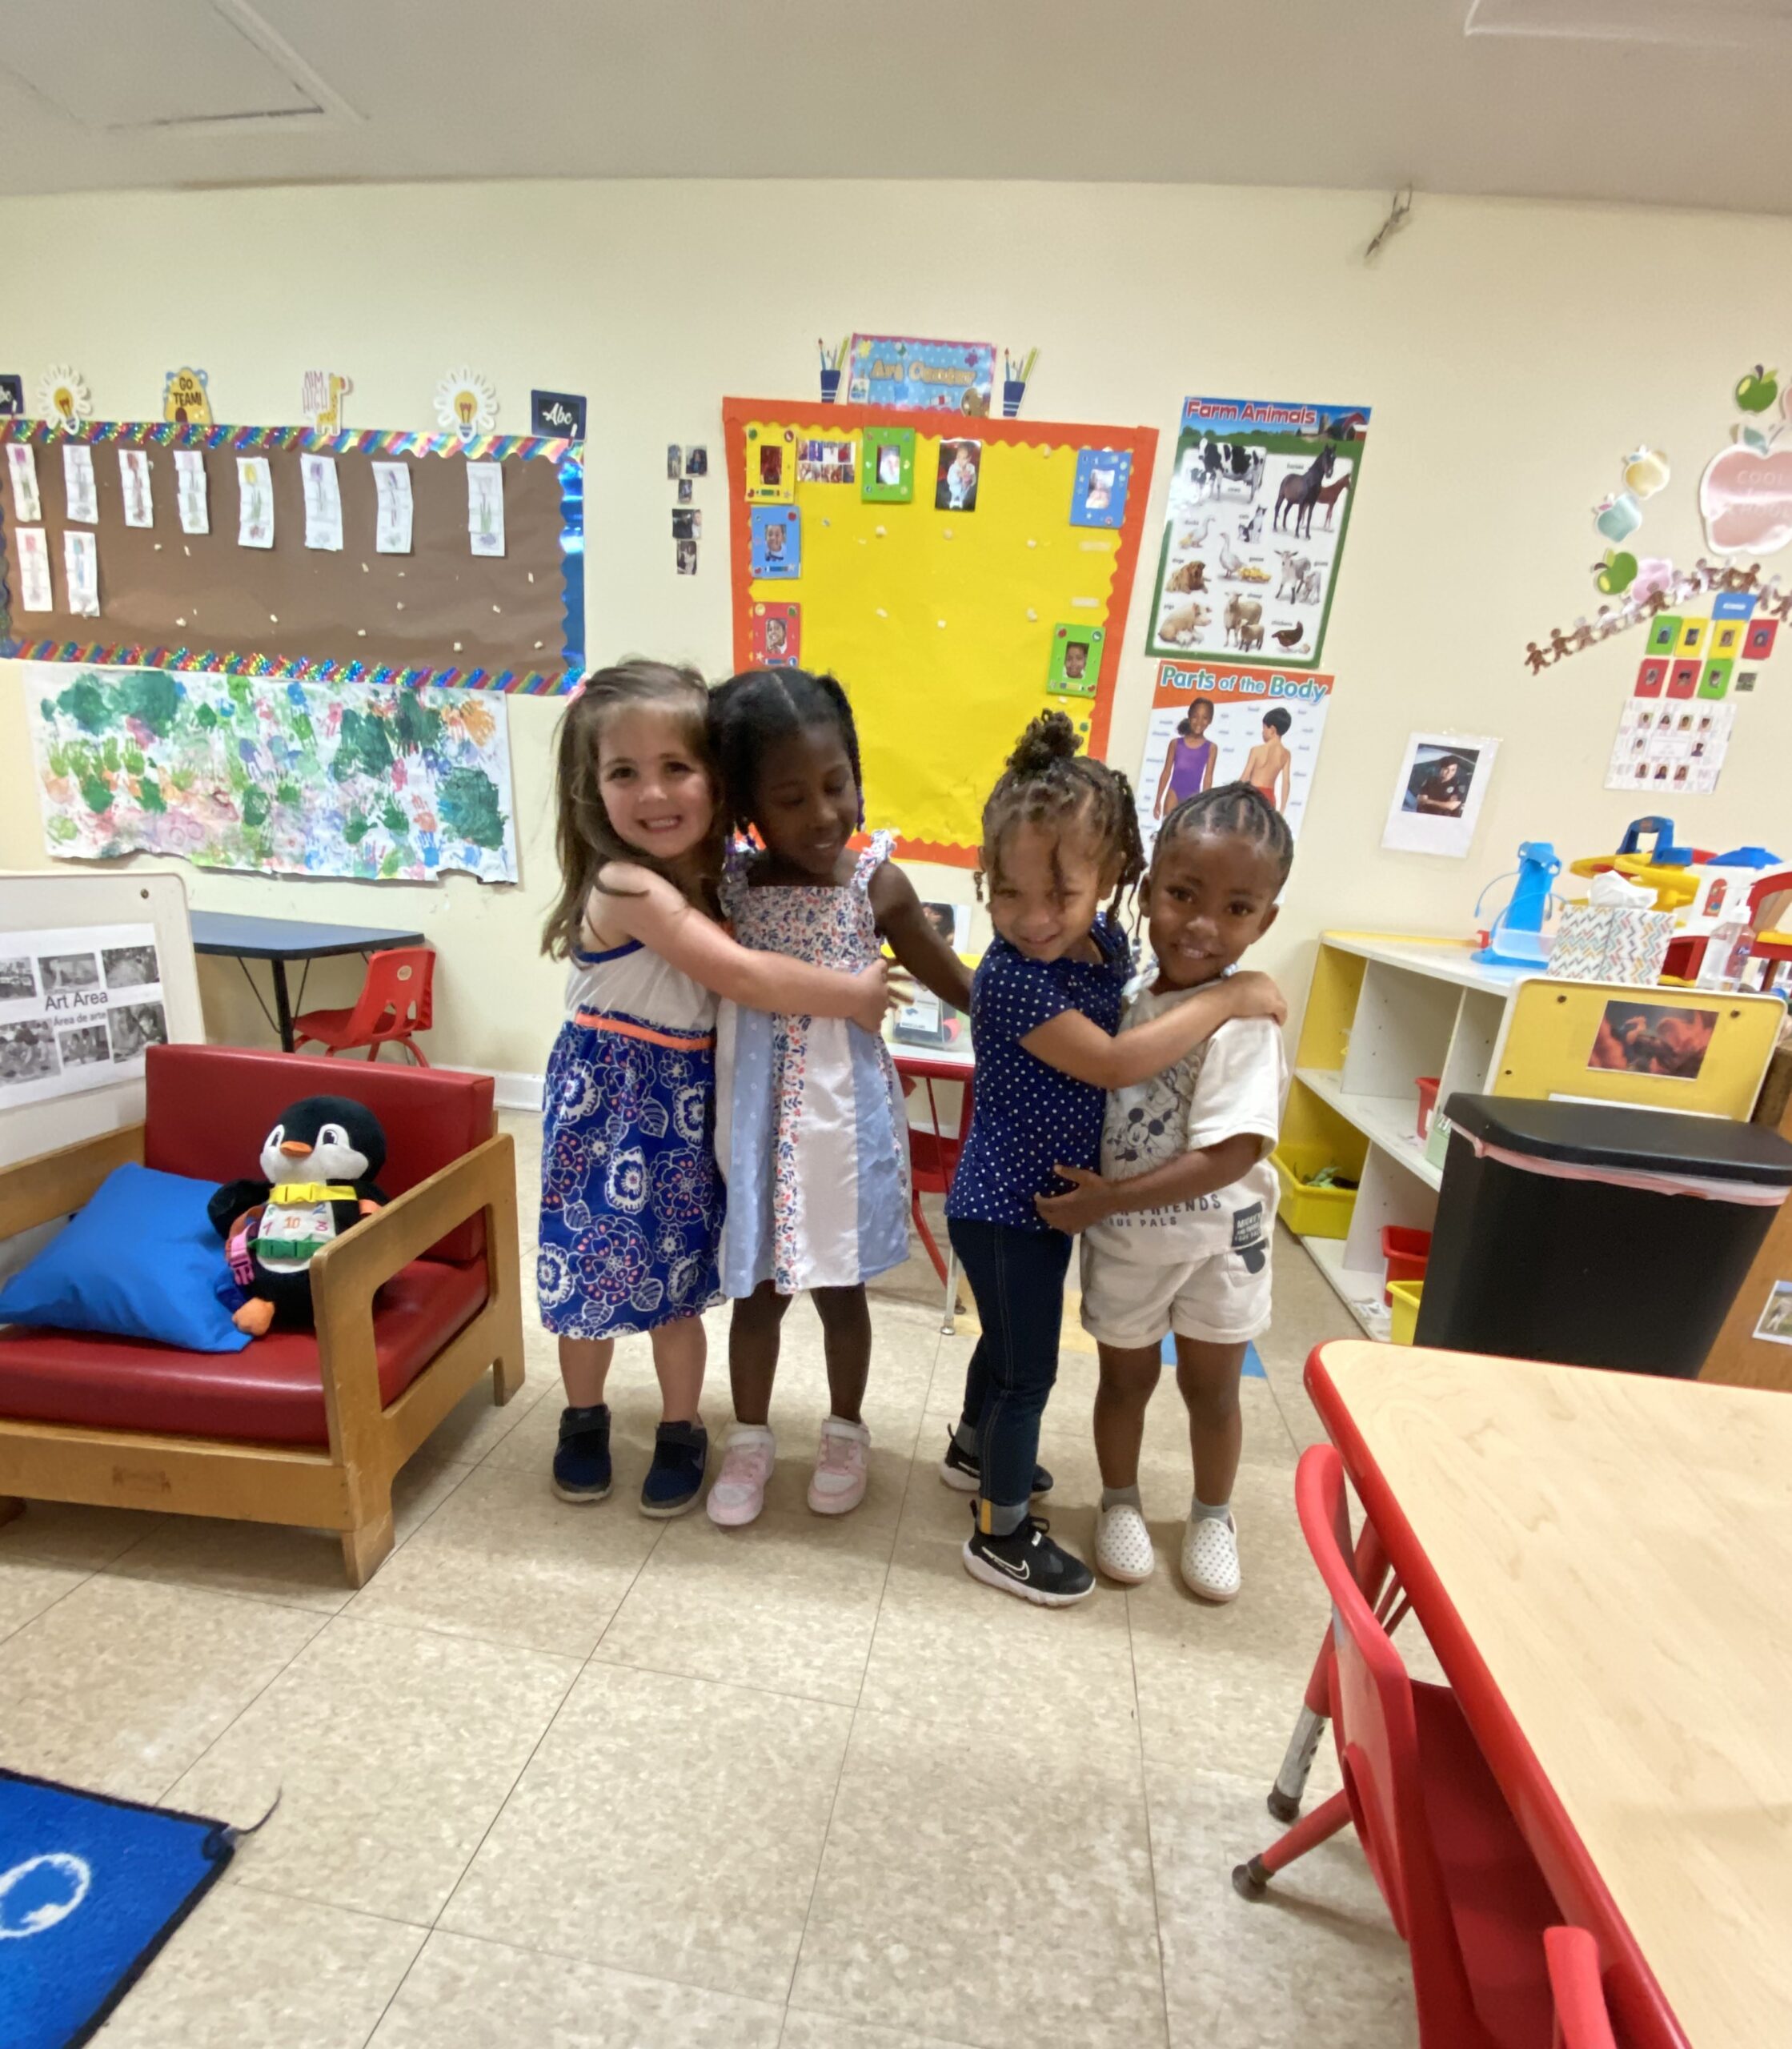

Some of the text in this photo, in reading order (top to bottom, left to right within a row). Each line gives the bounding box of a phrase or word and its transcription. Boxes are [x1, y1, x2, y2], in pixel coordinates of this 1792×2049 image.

[870, 359, 904, 382] Art
[179, 377, 194, 391] GO
[542, 402, 572, 426] Abc
[1187, 400, 1317, 424] Farm Animals
[1737, 470, 1786, 486] COOL
[1161, 665, 1328, 704] Parts of the Body
[45, 991, 108, 1012] Art Area
[77, 1012, 87, 1023] de
[312, 1201, 327, 1215] 2
[263, 1221, 273, 1236] 1
[283, 1217, 301, 1229] 10
[315, 1220, 328, 1232] 3
[1140, 1216, 1177, 1227] PALS
